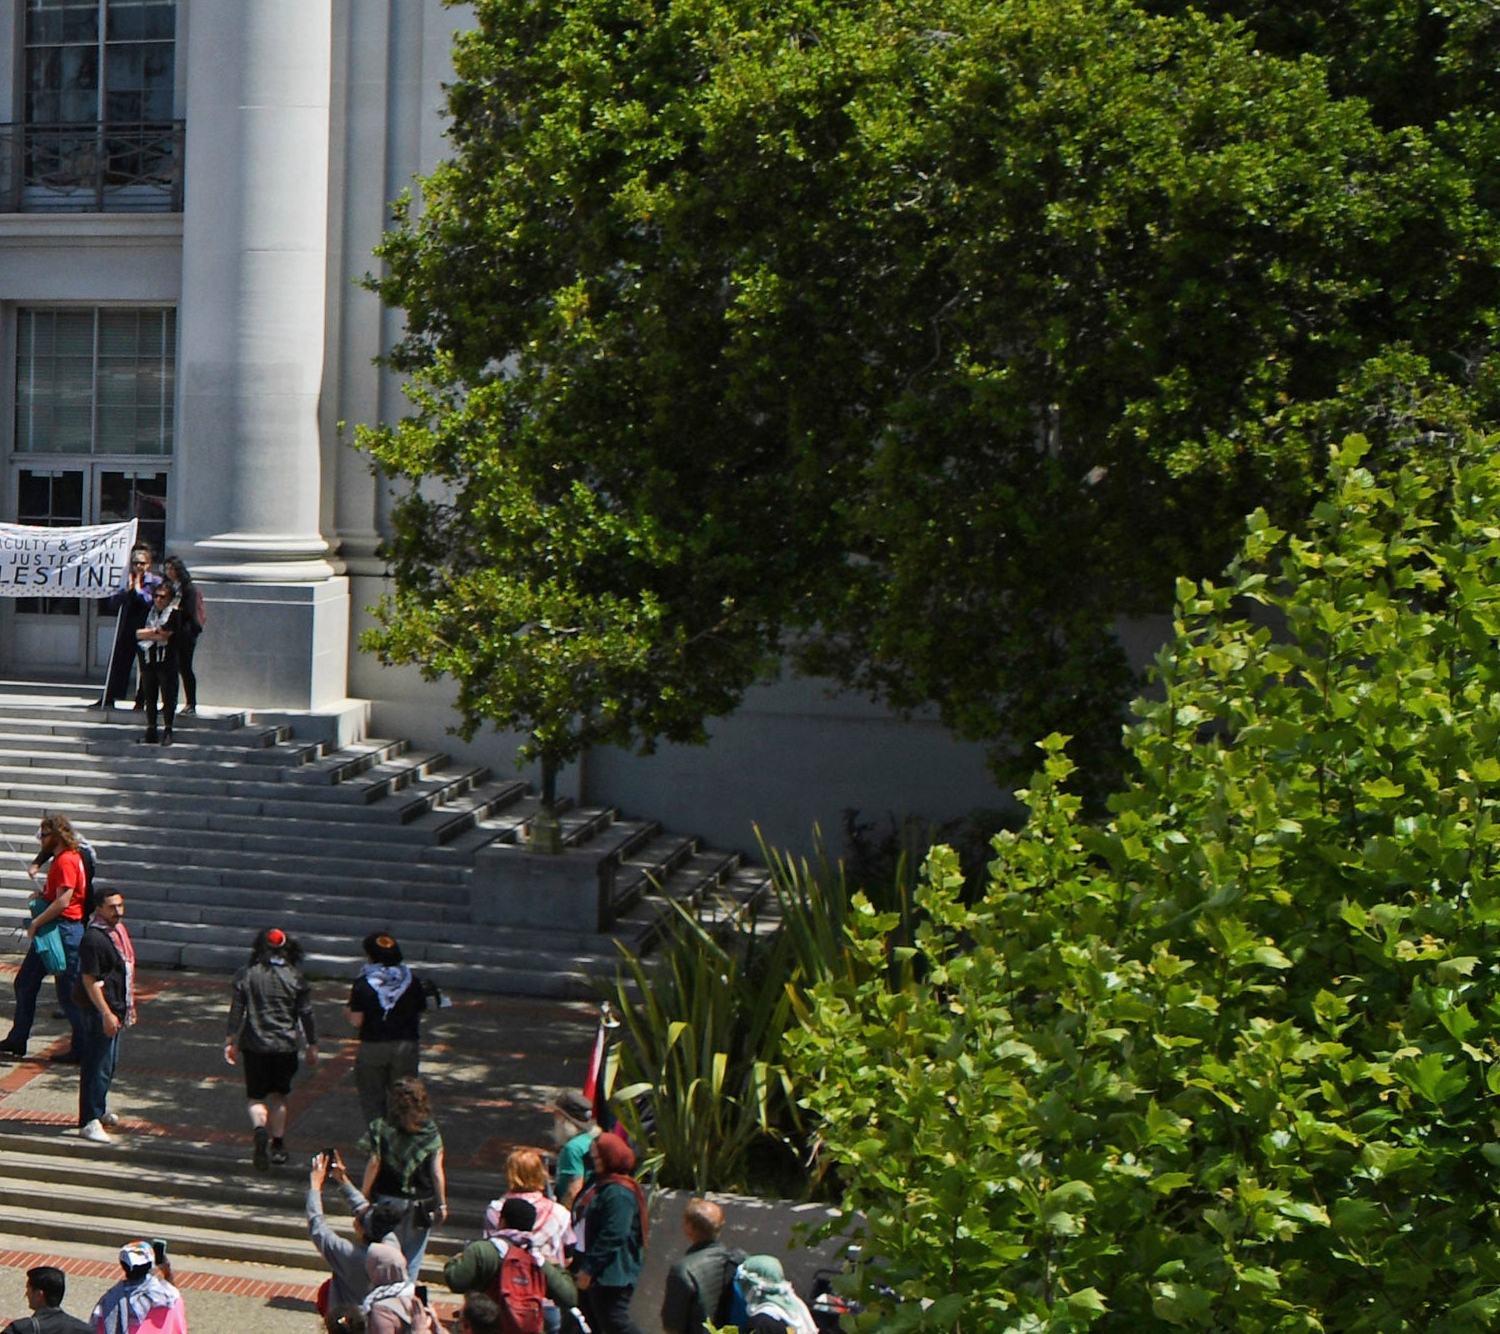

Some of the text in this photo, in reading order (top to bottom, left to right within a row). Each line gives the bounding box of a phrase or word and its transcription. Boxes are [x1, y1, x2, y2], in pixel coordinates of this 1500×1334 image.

[58, 539, 71, 552] &
[79, 537, 127, 551] STAFF
[9, 553, 89, 567] JUSTICE
[98, 553, 115, 565] IN
